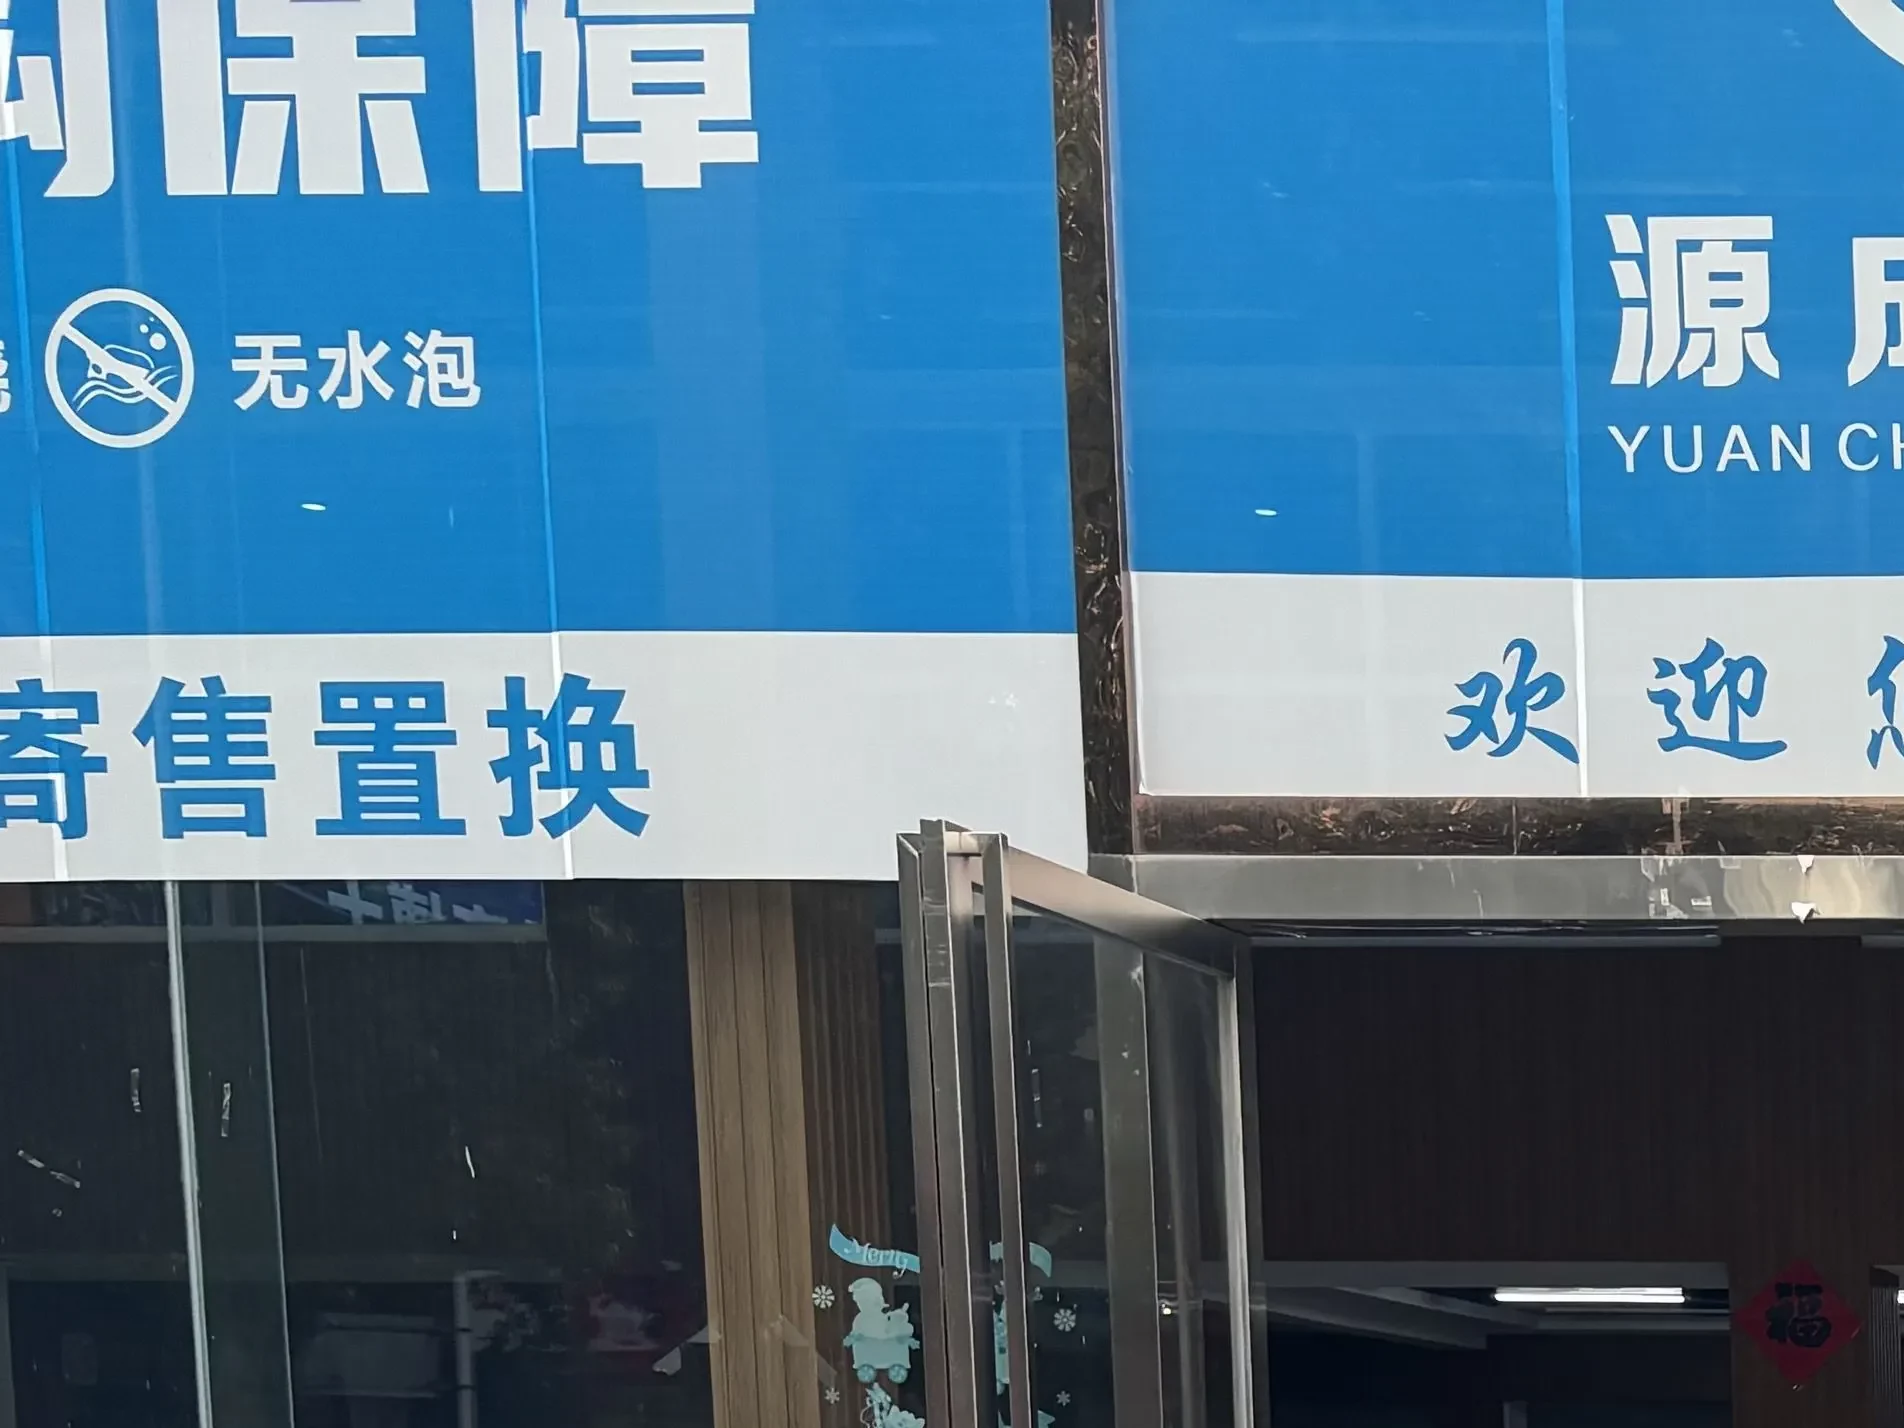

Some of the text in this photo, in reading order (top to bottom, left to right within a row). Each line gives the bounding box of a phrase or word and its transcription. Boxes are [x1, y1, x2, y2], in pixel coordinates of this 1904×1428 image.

[231, 330, 482, 411] 无水泡
[1607, 425, 1811, 474] YUAN
[0, 672, 651, 839] 寄售置换
[1764, 1281, 1832, 1348] 福
